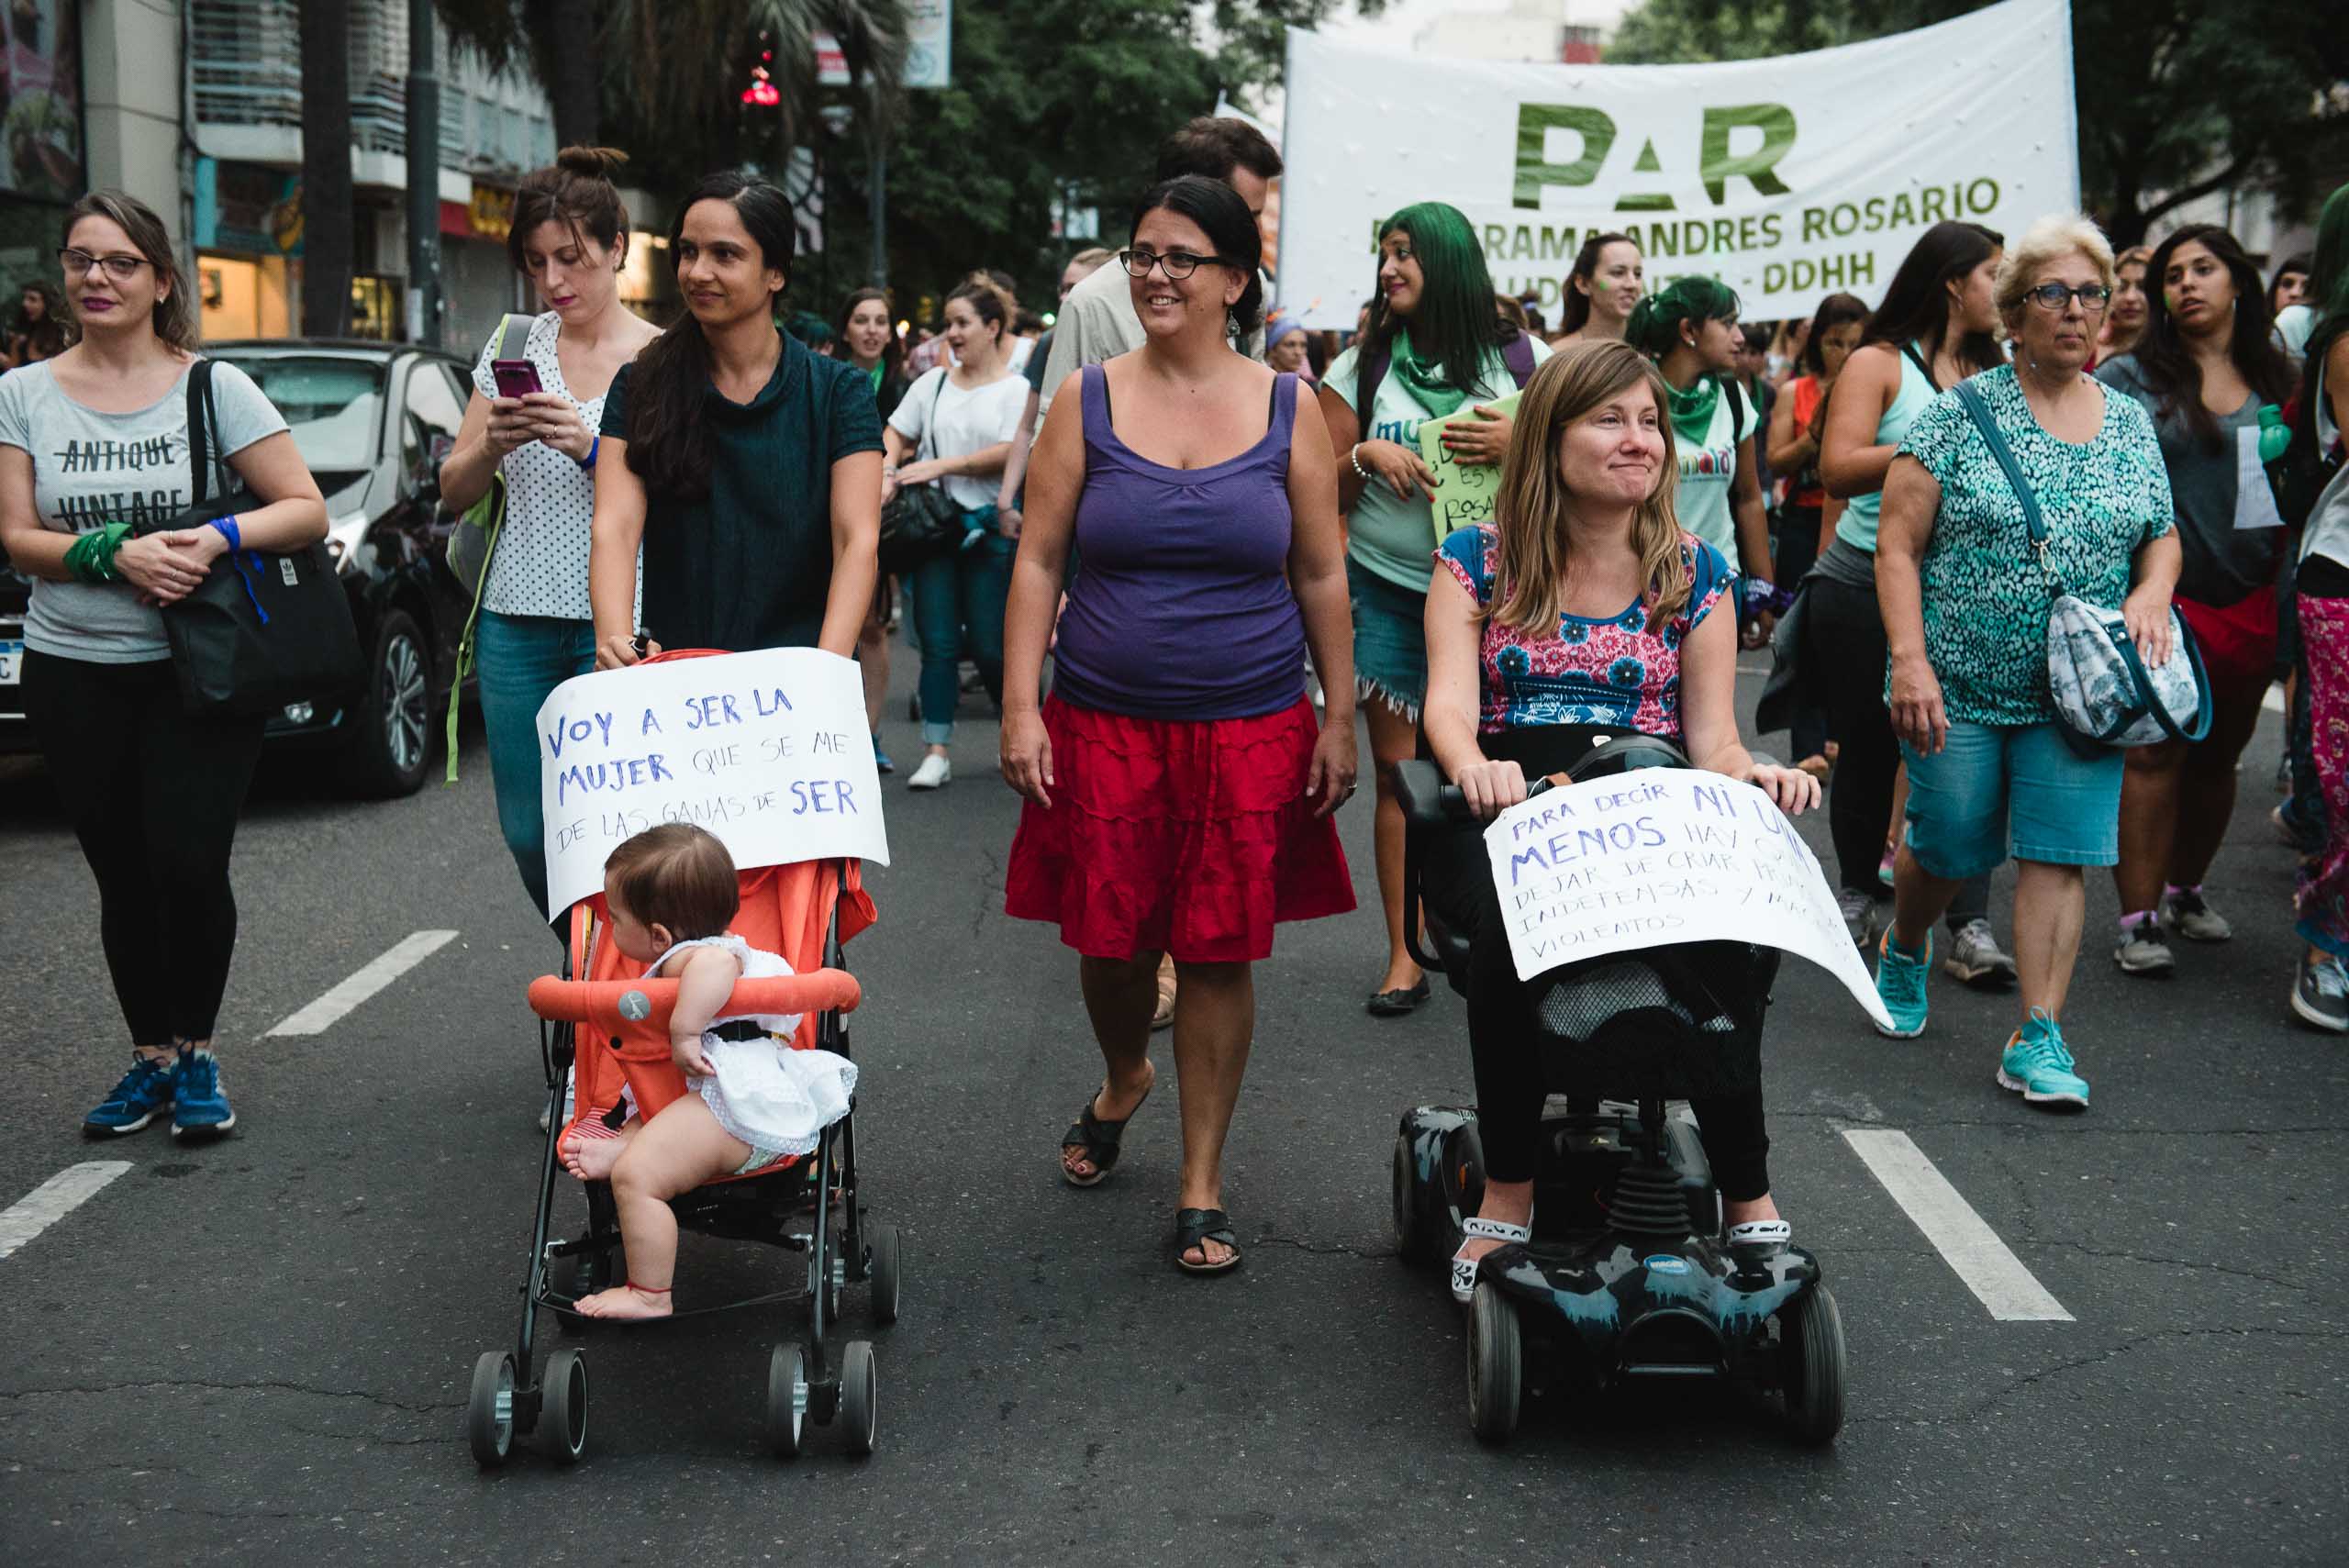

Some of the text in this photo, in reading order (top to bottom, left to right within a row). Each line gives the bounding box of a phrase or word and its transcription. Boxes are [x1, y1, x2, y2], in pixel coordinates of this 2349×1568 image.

[1512, 102, 1797, 212] PAR
[1802, 177, 2000, 243] ROSARIO
[1763, 250, 1875, 295] DDHH
[62, 432, 175, 473] ANTIQUE
[549, 688, 793, 758] VOY A SER LA
[559, 730, 852, 807] MUJER QUE SE ME
[557, 779, 858, 853] DE LAS GANAS DE SER
[1512, 802, 1576, 841] PARA
[1511, 816, 1738, 887] MENOS HAY
[1514, 865, 1607, 910] DEJAR
[1623, 857, 1653, 876] DE
[1520, 878, 1720, 937] INDEFENSAS
[1531, 912, 1687, 959] VIOLENTOS
